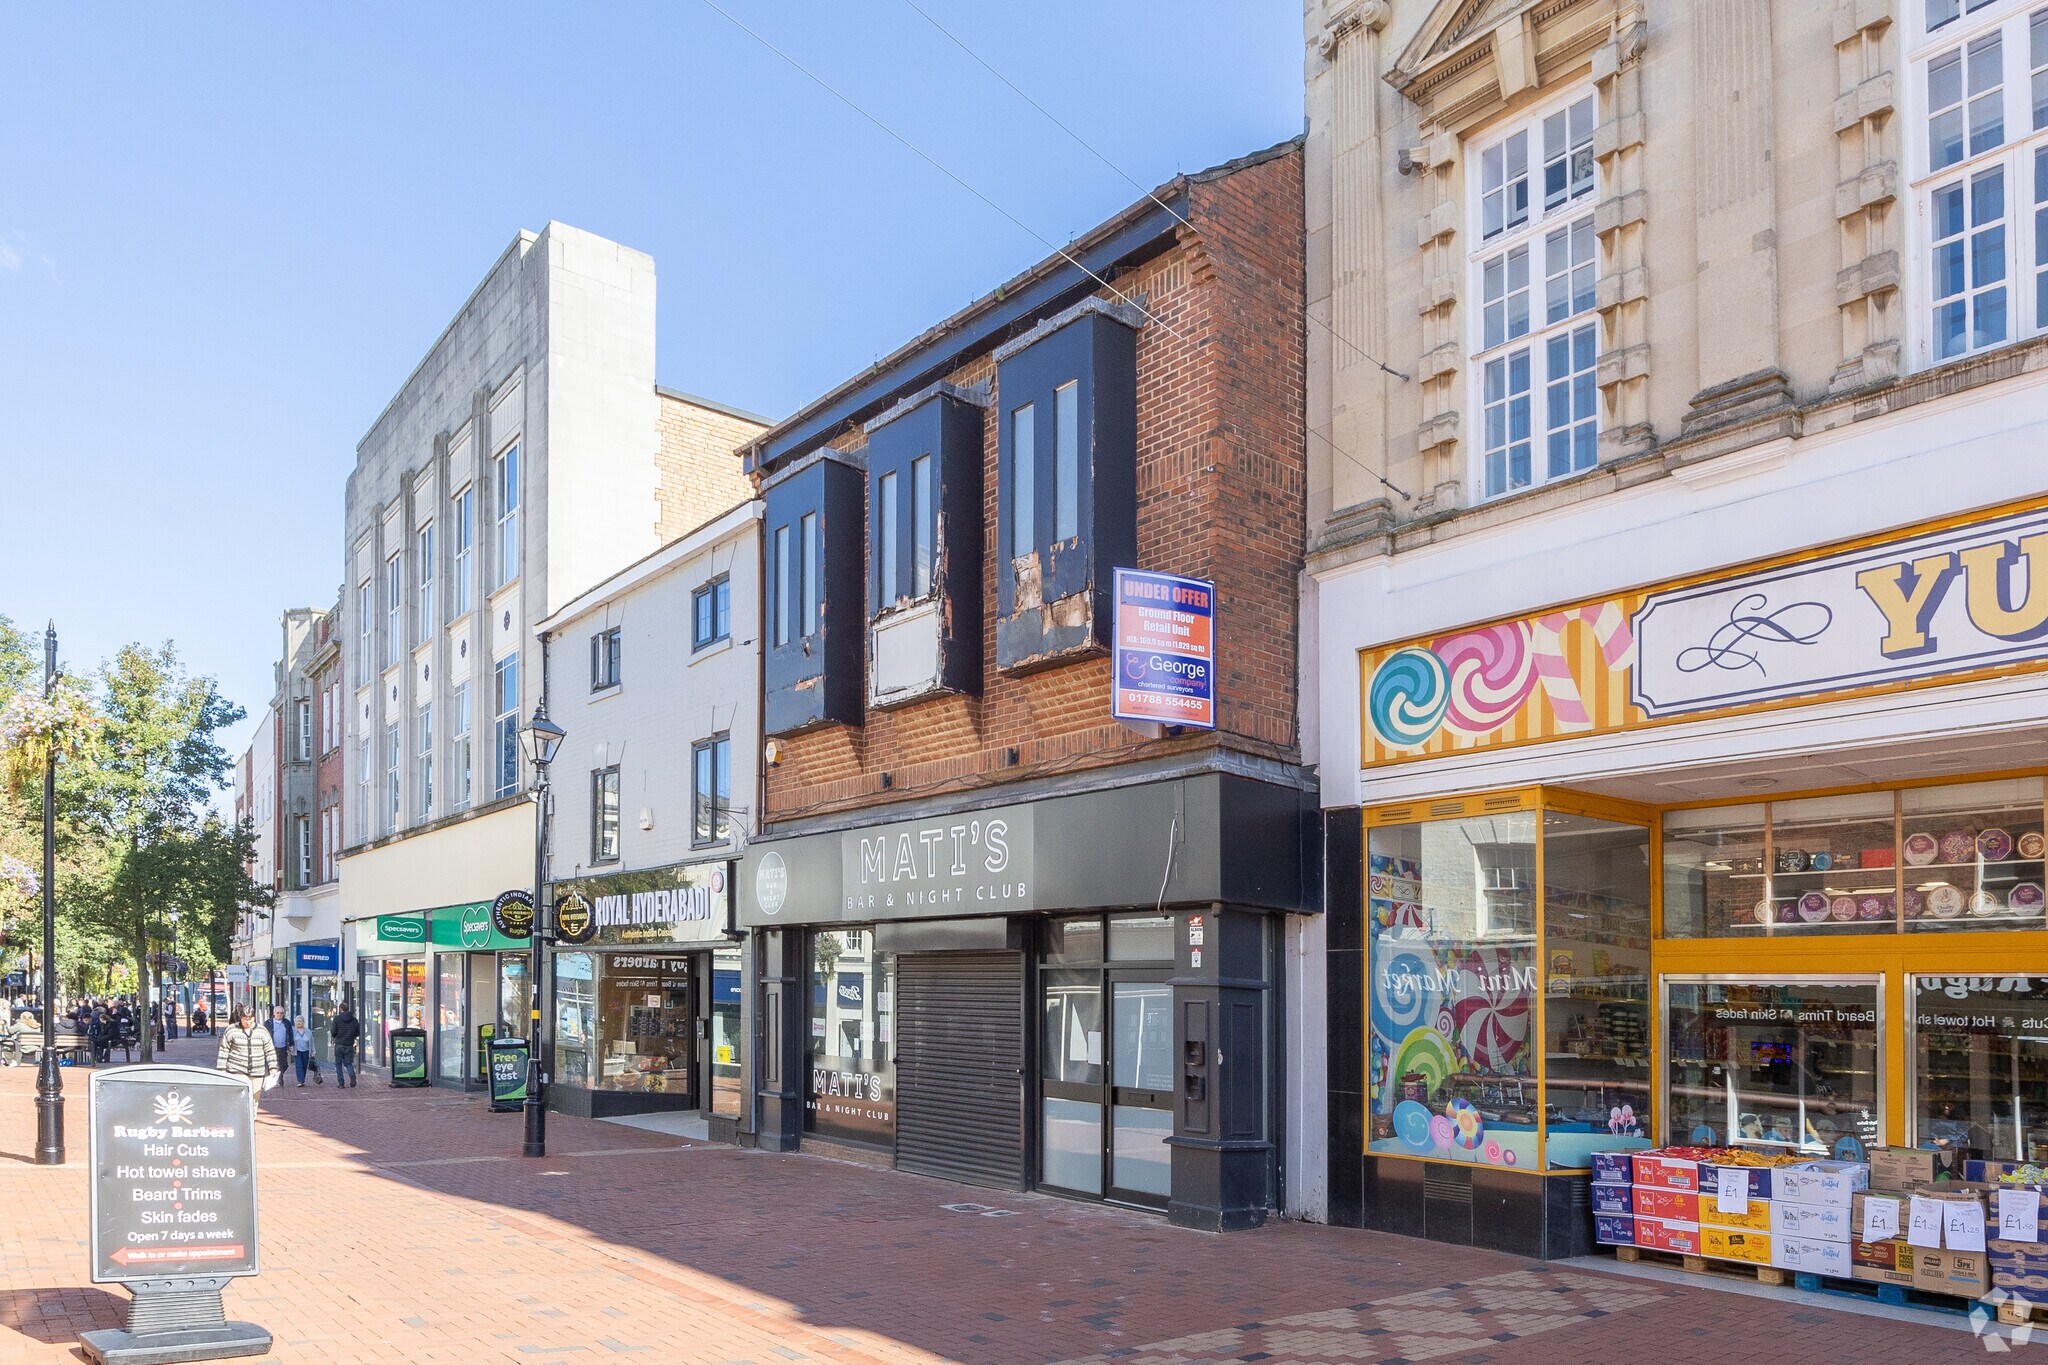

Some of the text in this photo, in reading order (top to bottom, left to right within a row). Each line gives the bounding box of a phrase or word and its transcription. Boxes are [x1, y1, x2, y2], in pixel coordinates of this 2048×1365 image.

[1124, 580, 1209, 609] UNDER OFFER
[1138, 606, 1195, 624] Ground Floor
[1143, 620, 1191, 637] Retail Unit
[1157, 639, 1165, 647] sq
[1190, 643, 1198, 652] sq
[1149, 655, 1205, 679] George
[1137, 680, 1194, 694] chartered surveyors
[1169, 676, 1205, 690] company
[1128, 693, 1203, 710] 01788 554455
[860, 819, 1009, 884] MATI'S
[510, 892, 534, 904] INDIAN
[847, 882, 1026, 909] BAR & NIGHT CLUB
[595, 887, 711, 927] ROYAL HYDERABADI
[384, 925, 419, 933] Specsavers
[464, 920, 489, 935] Specsavers
[395, 1040, 416, 1048] Free
[396, 1047, 412, 1056] eye
[396, 1054, 415, 1062] test
[493, 1053, 518, 1062] Free
[494, 1063, 514, 1073] eye
[495, 1071, 518, 1081] test
[813, 1069, 881, 1102] MATI'S
[806, 1100, 889, 1121] BAR & NIGHT CLUB
[113, 1125, 235, 1140] Rugby Barbers
[144, 1143, 209, 1156] Hair Cuts
[117, 1165, 236, 1179] Hot towel shave
[132, 1188, 222, 1201] Beard Trims
[1725, 1185, 1738, 1199] £1
[141, 1210, 217, 1224] Skin fades
[1913, 1215, 1937, 1231] £1.25
[2005, 1213, 2034, 1231] £1.50
[1950, 1218, 1980, 1234] £1.25
[127, 1231, 159, 1243] Open
[160, 1231, 168, 1240] 7
[170, 1231, 196, 1242] days
[206, 1229, 234, 1239] week
[166, 1250, 187, 1258] make
[188, 1248, 236, 1257] appointment
